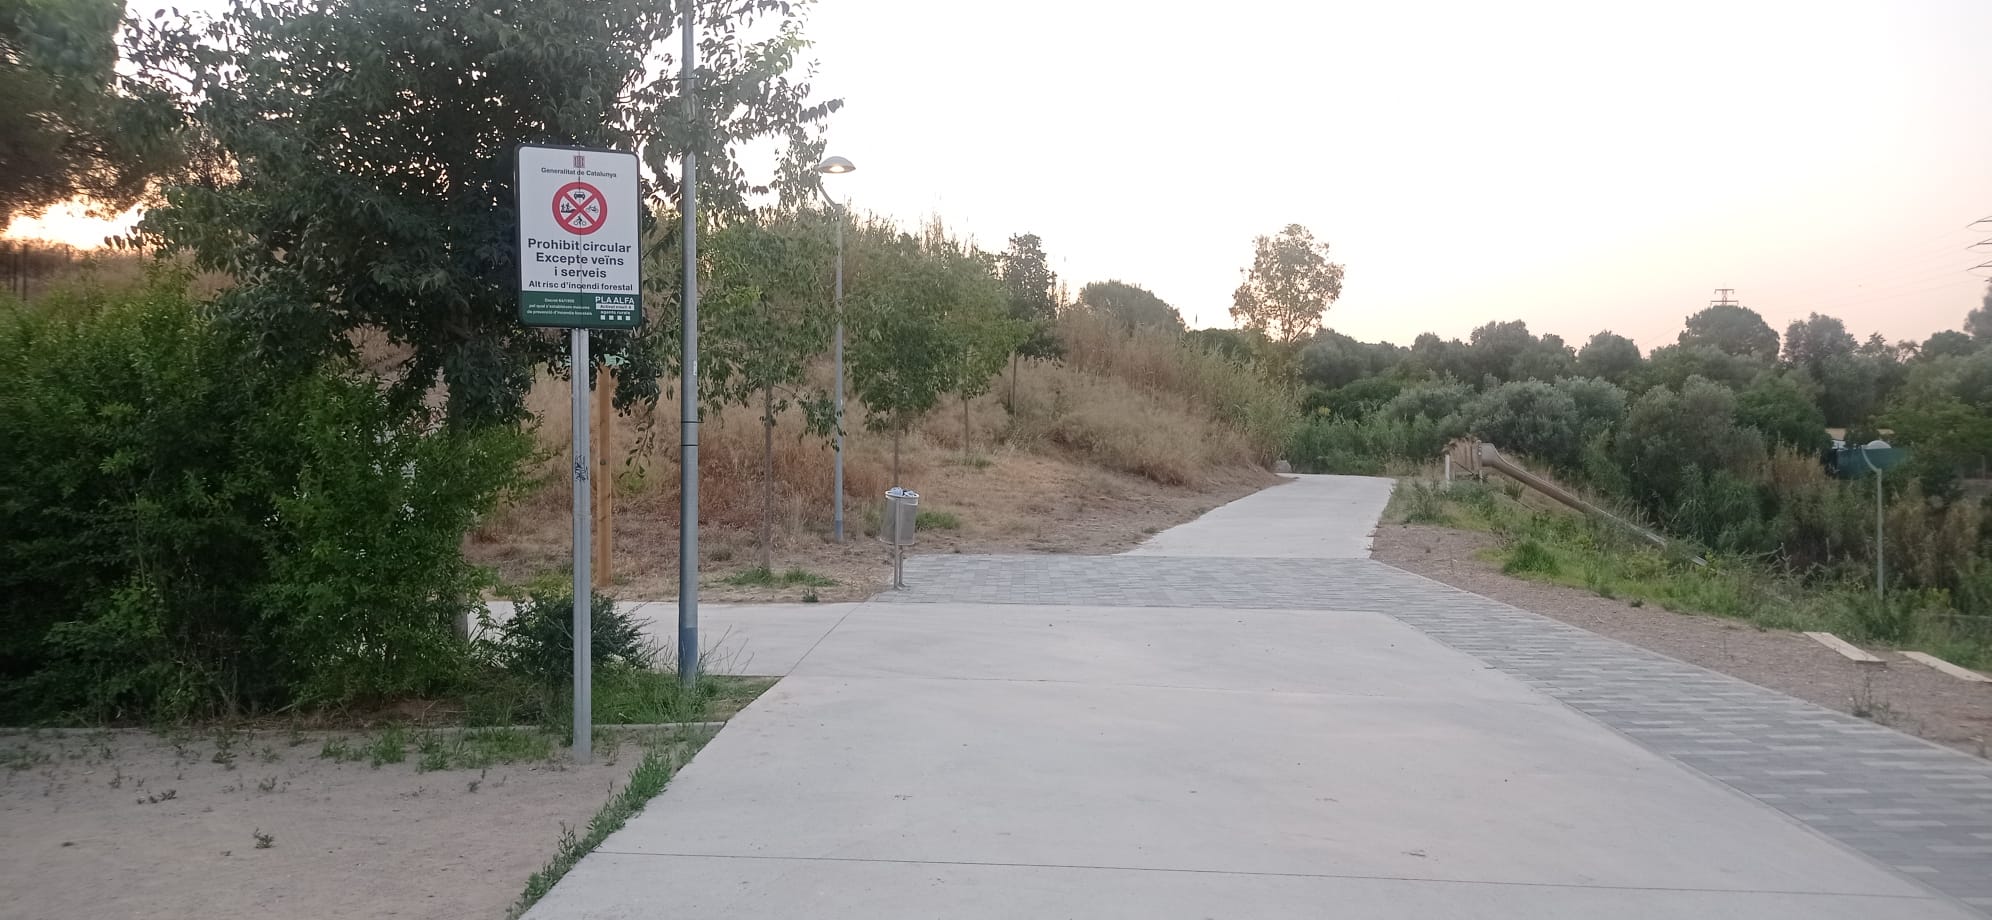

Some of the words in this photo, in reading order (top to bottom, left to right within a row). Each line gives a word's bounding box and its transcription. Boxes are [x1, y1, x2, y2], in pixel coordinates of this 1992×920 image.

[541, 167, 576, 175] Generalitat
[586, 170, 617, 178] Catalunya
[528, 238, 580, 251] Prohibit
[583, 242, 632, 253] circular
[536, 252, 588, 265] Excepte
[591, 255, 624, 266] veïns
[554, 266, 558, 276] i
[561, 268, 607, 278] serveis
[528, 280, 541, 288] Alt
[560, 282, 600, 290] d'incendi
[601, 283, 633, 291] forestal
[595, 296, 612, 304] PLA
[613, 296, 634, 304] ALFA
